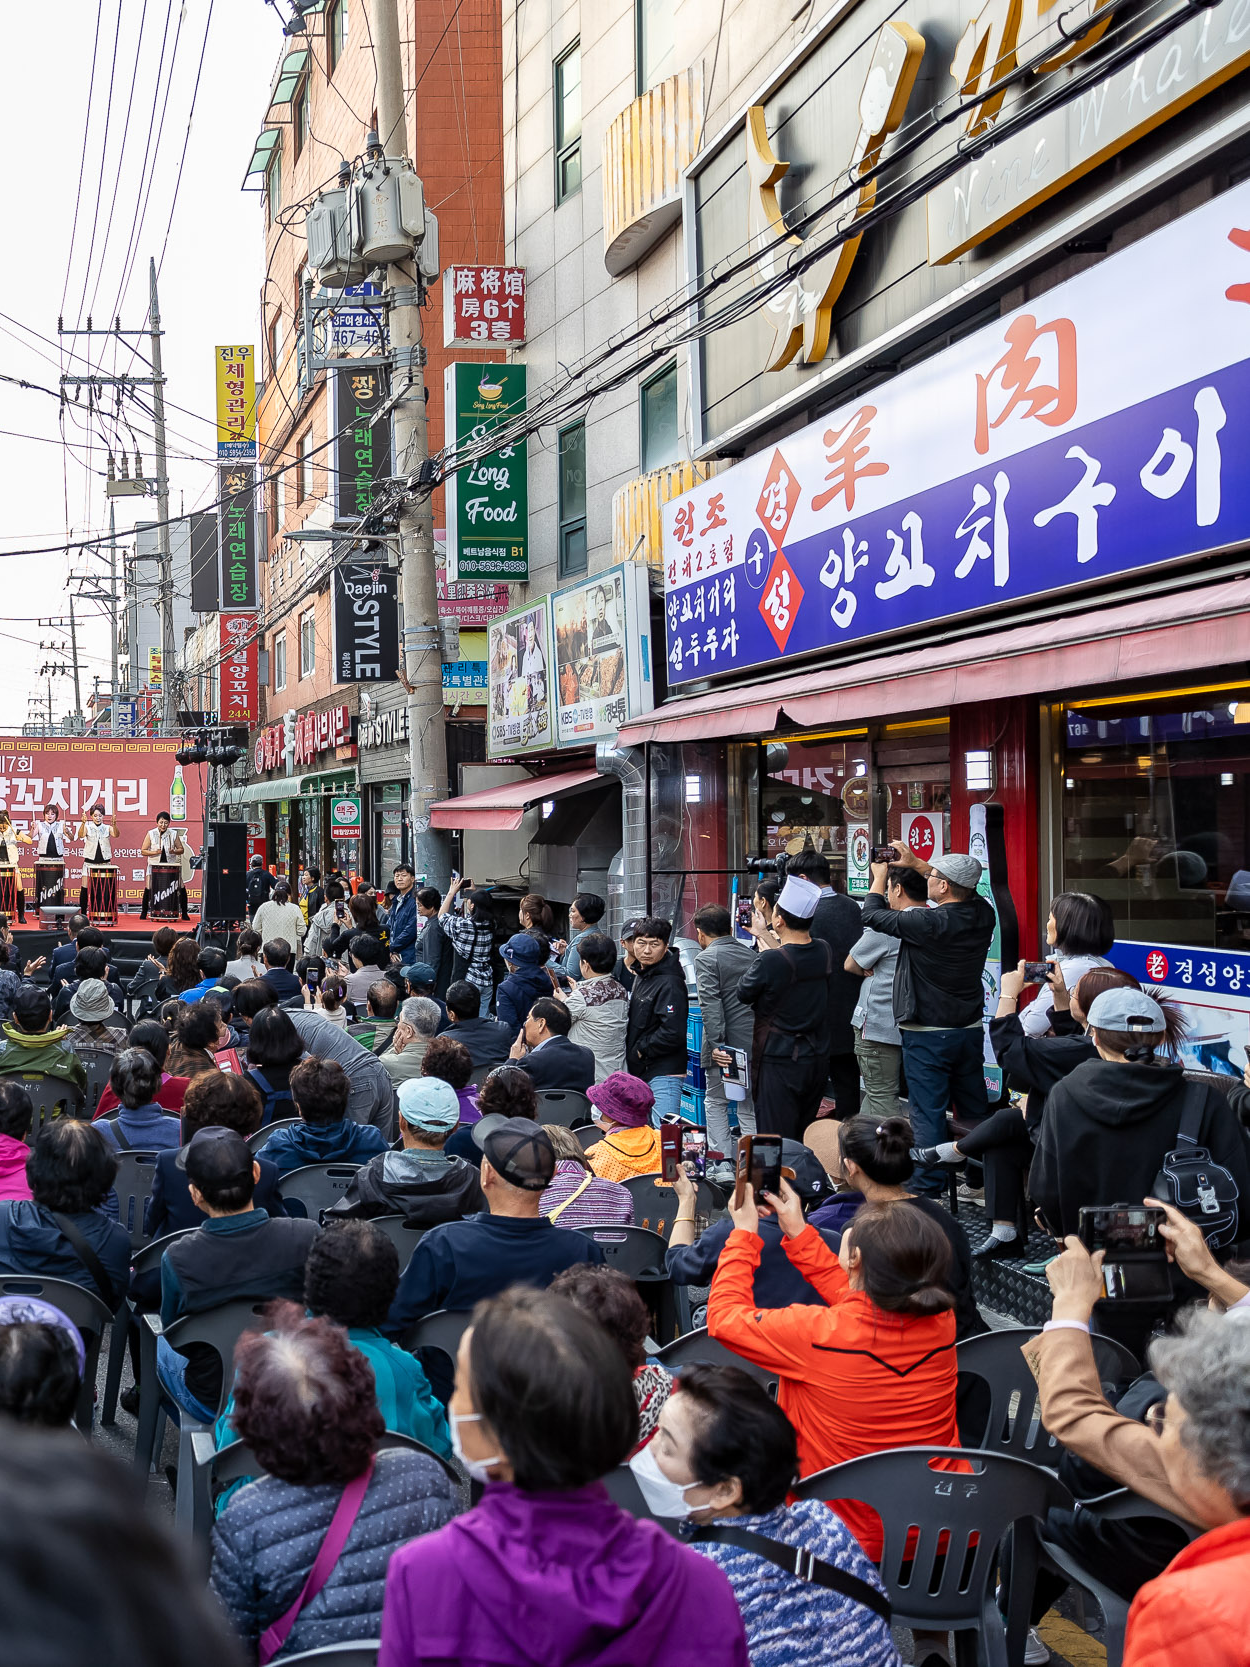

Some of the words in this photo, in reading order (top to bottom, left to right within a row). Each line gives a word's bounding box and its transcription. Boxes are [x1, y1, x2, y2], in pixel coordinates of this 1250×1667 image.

[946, 137, 1052, 238] Nine
[456, 268, 523, 296] 麻将馆
[461, 298, 519, 318] 房6个
[470, 321, 510, 339] 3층
[220, 347, 251, 361] 진우
[224, 363, 247, 430] 체형관리
[352, 375, 376, 399] 짱
[226, 472, 245, 494] 짱
[466, 458, 510, 491] Long
[465, 496, 518, 525] Food
[673, 492, 728, 547] 원조
[819, 386, 1227, 629] 양꼬치구이
[228, 502, 248, 601] 노래연습장
[463, 547, 506, 557] 베트남음식점
[511, 546, 524, 557] B1
[748, 541, 764, 575] 구
[762, 469, 791, 631] 경성
[345, 582, 387, 595] Daejin
[668, 572, 736, 632] 양꼬치거리
[353, 600, 381, 678] STYLE
[669, 618, 740, 671] 선두주자
[228, 709, 250, 718] 24시
[375, 706, 410, 746] STYLE
[561, 711, 573, 726] KBS
[336, 805, 356, 816] 맥주
[910, 826, 933, 850] 원조
[1148, 953, 1165, 979] 老
[1175, 958, 1250, 990] 경성양
